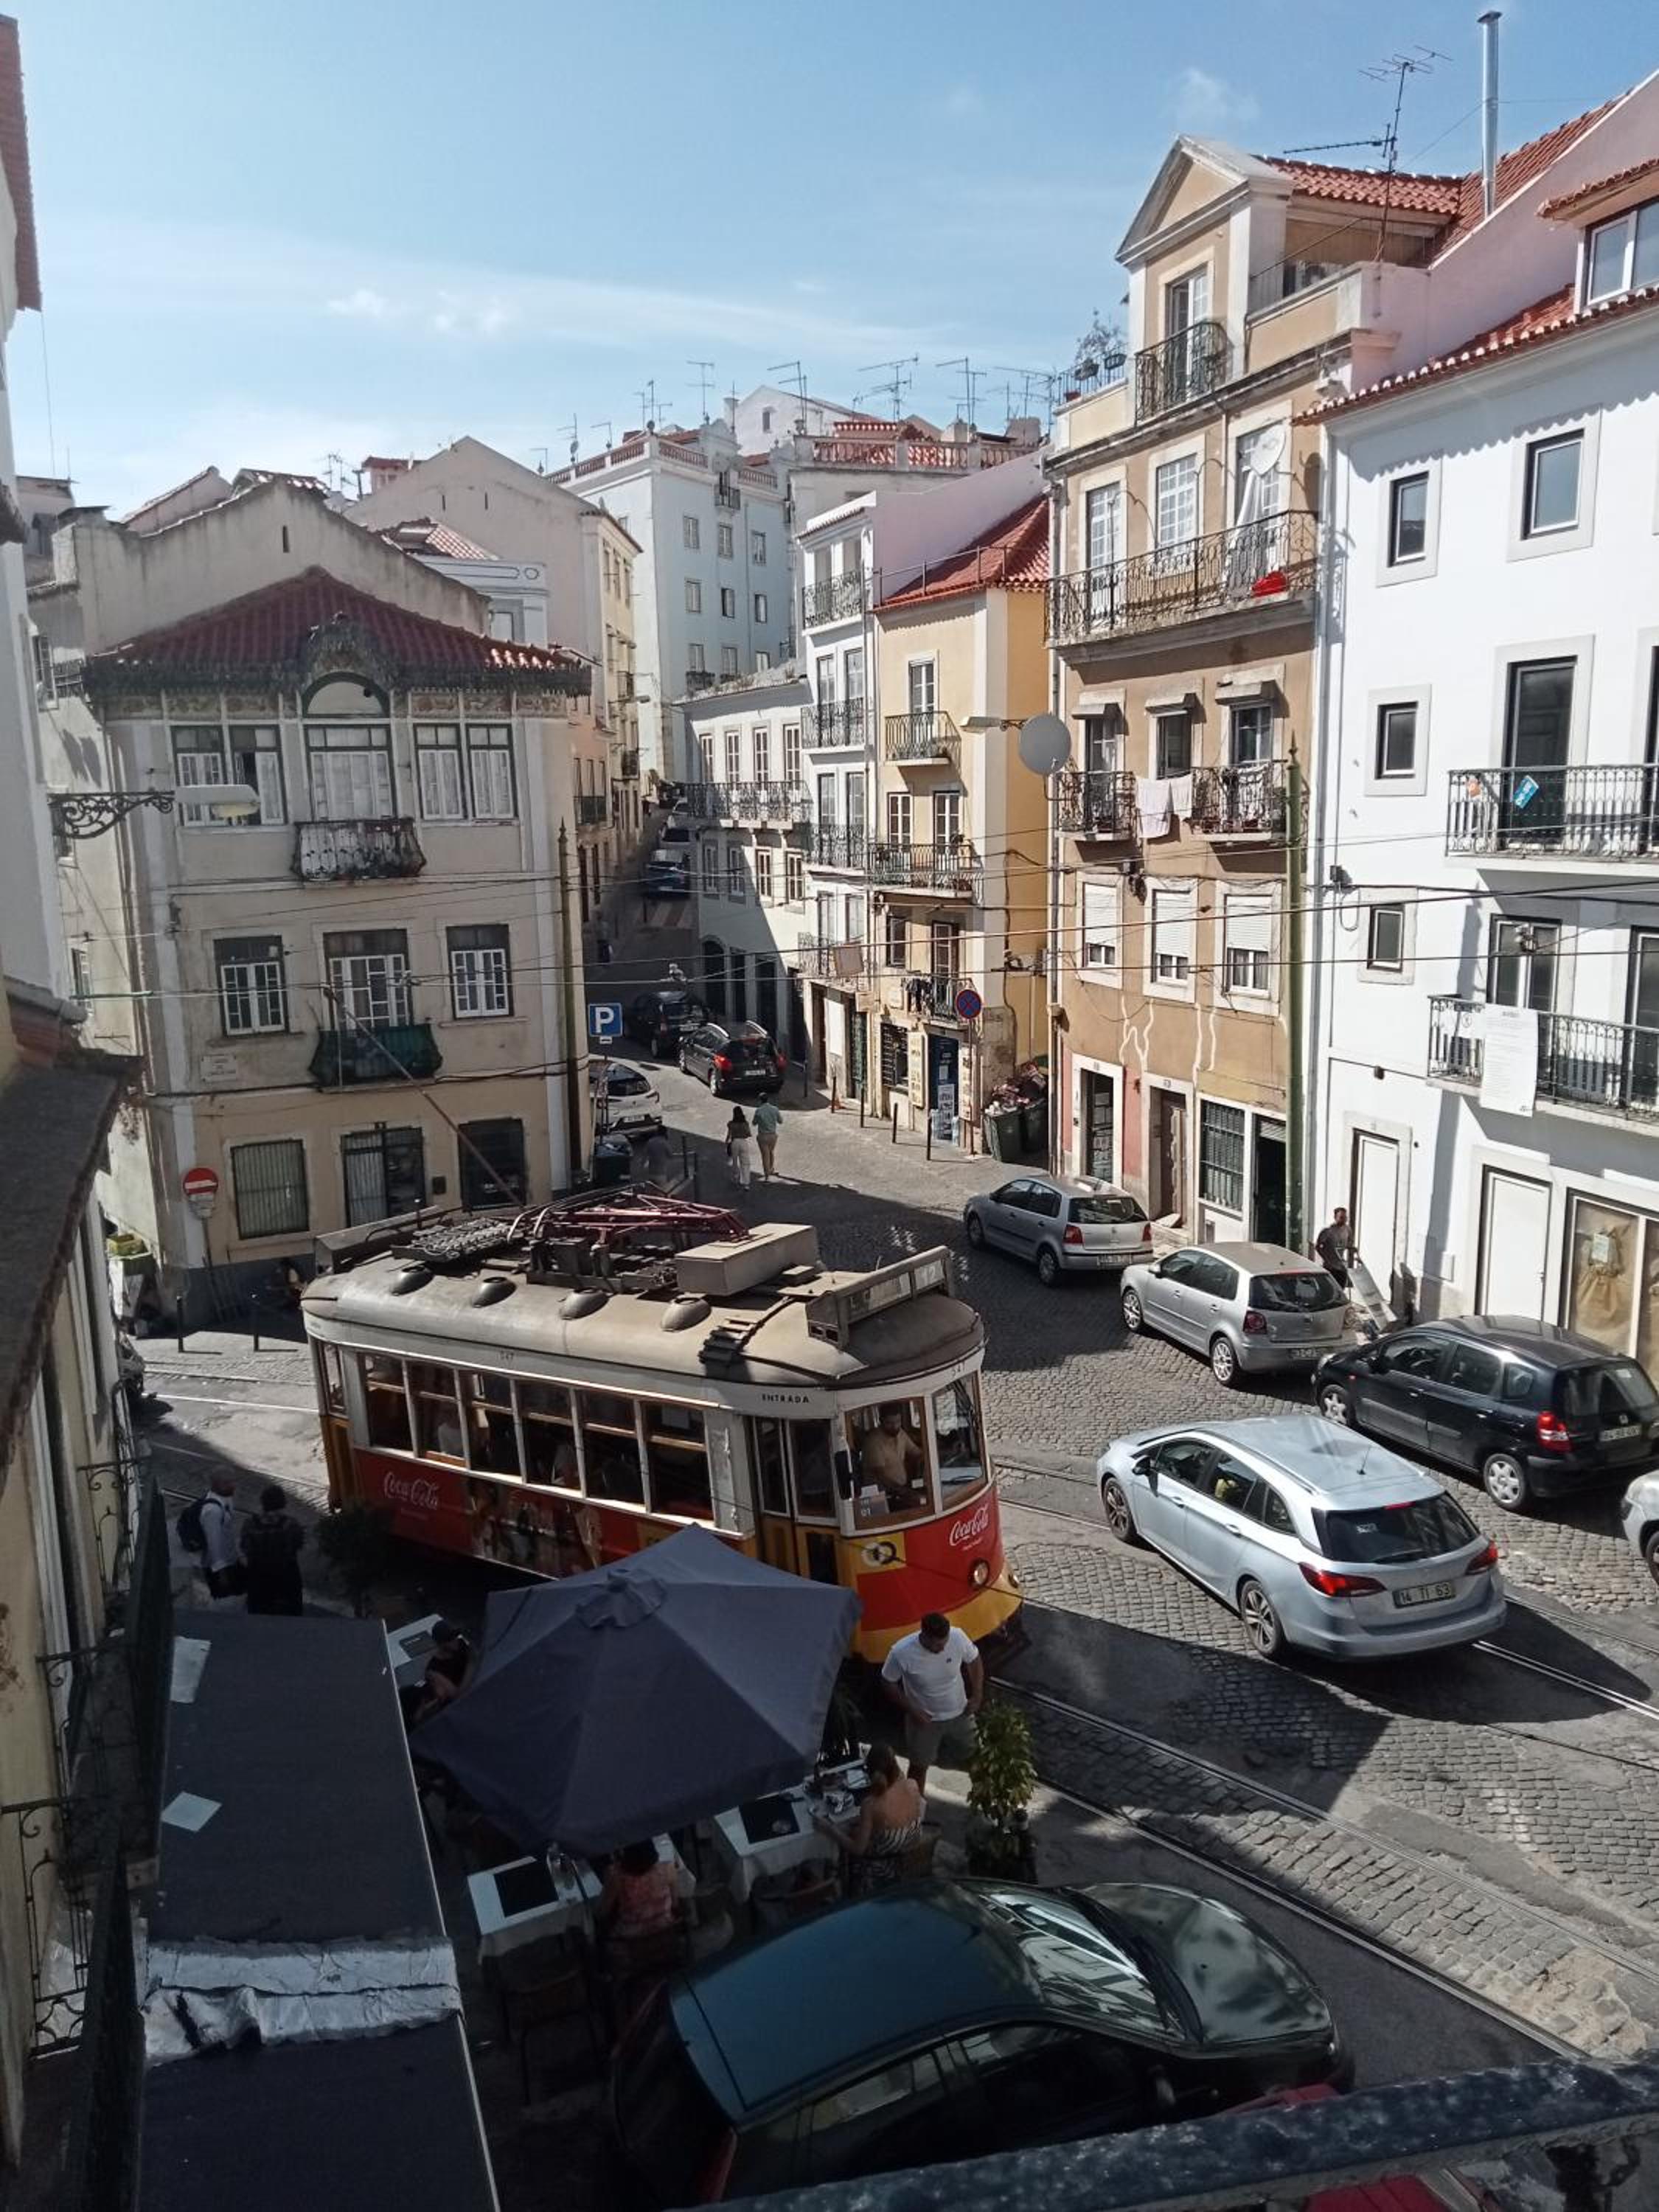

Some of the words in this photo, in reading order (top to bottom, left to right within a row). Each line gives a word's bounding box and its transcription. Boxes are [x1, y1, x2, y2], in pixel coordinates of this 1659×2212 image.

[595, 1006, 614, 1033] P
[762, 1394, 809, 1403] ENTRADA
[949, 1503, 990, 1546] Coca-Cola
